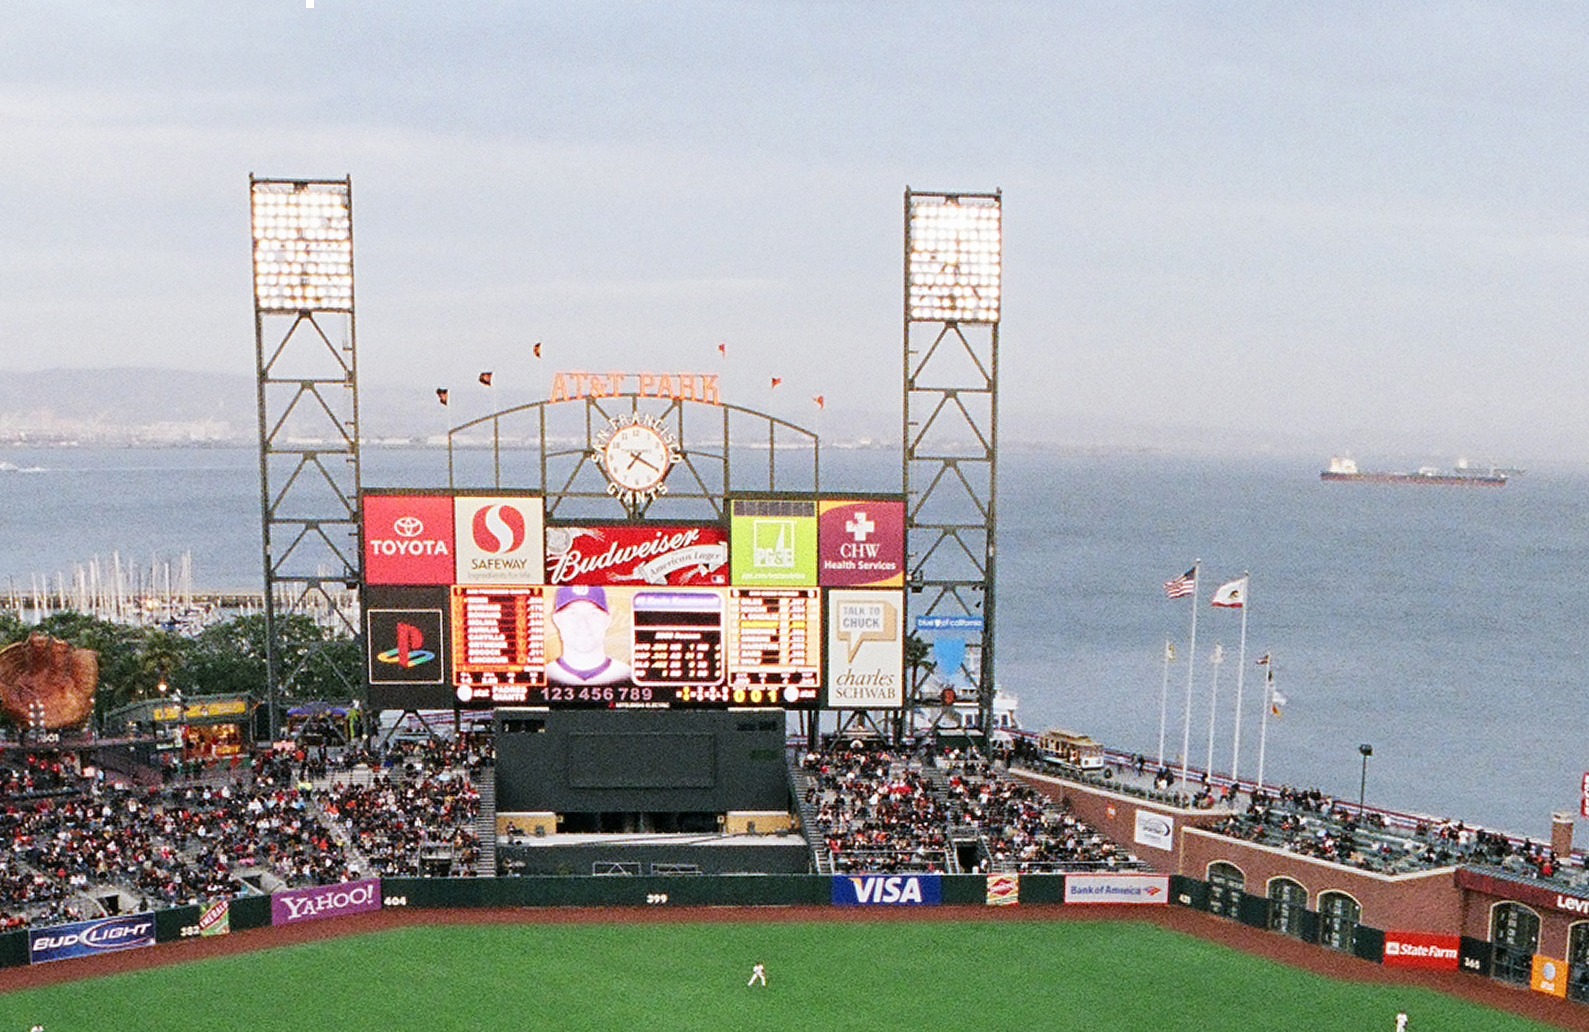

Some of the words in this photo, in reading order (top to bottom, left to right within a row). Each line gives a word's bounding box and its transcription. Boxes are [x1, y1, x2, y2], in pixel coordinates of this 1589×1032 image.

[550, 373, 626, 403] AT&T
[638, 374, 720, 405] PARK
[591, 430, 610, 463] SAN
[609, 411, 683, 464] FRANCISCO
[607, 482, 668, 504] GIANTS
[370, 540, 449, 556] TOYOTA
[840, 543, 880, 559] CHW
[471, 558, 528, 570] SAFEWAY
[546, 528, 701, 585] Budweiser
[650, 554, 693, 577] American
[693, 549, 722, 562] Lager
[754, 548, 795, 568] PG&E
[824, 560, 856, 570] Health
[858, 560, 897, 571] Services
[843, 606, 868, 616] TALK
[869, 606, 881, 616] TO
[843, 617, 880, 628] CHUCK
[836, 668, 895, 687] charles
[492, 685, 528, 694] PADRES
[492, 693, 527, 702] GIANTS
[835, 687, 896, 700] SCHWAB
[848, 876, 923, 903] VISA
[1070, 885, 1093, 895] Bank
[1094, 885, 1104, 895] of
[1104, 885, 1141, 896] America
[279, 884, 375, 921] YAHOO!
[383, 896, 407, 906] 404
[646, 893, 668, 904] 399
[32, 935, 80, 951] BUD
[89, 922, 152, 942] LIGHT
[1399, 943, 1428, 957] State
[1428, 946, 1459, 959] Farm
